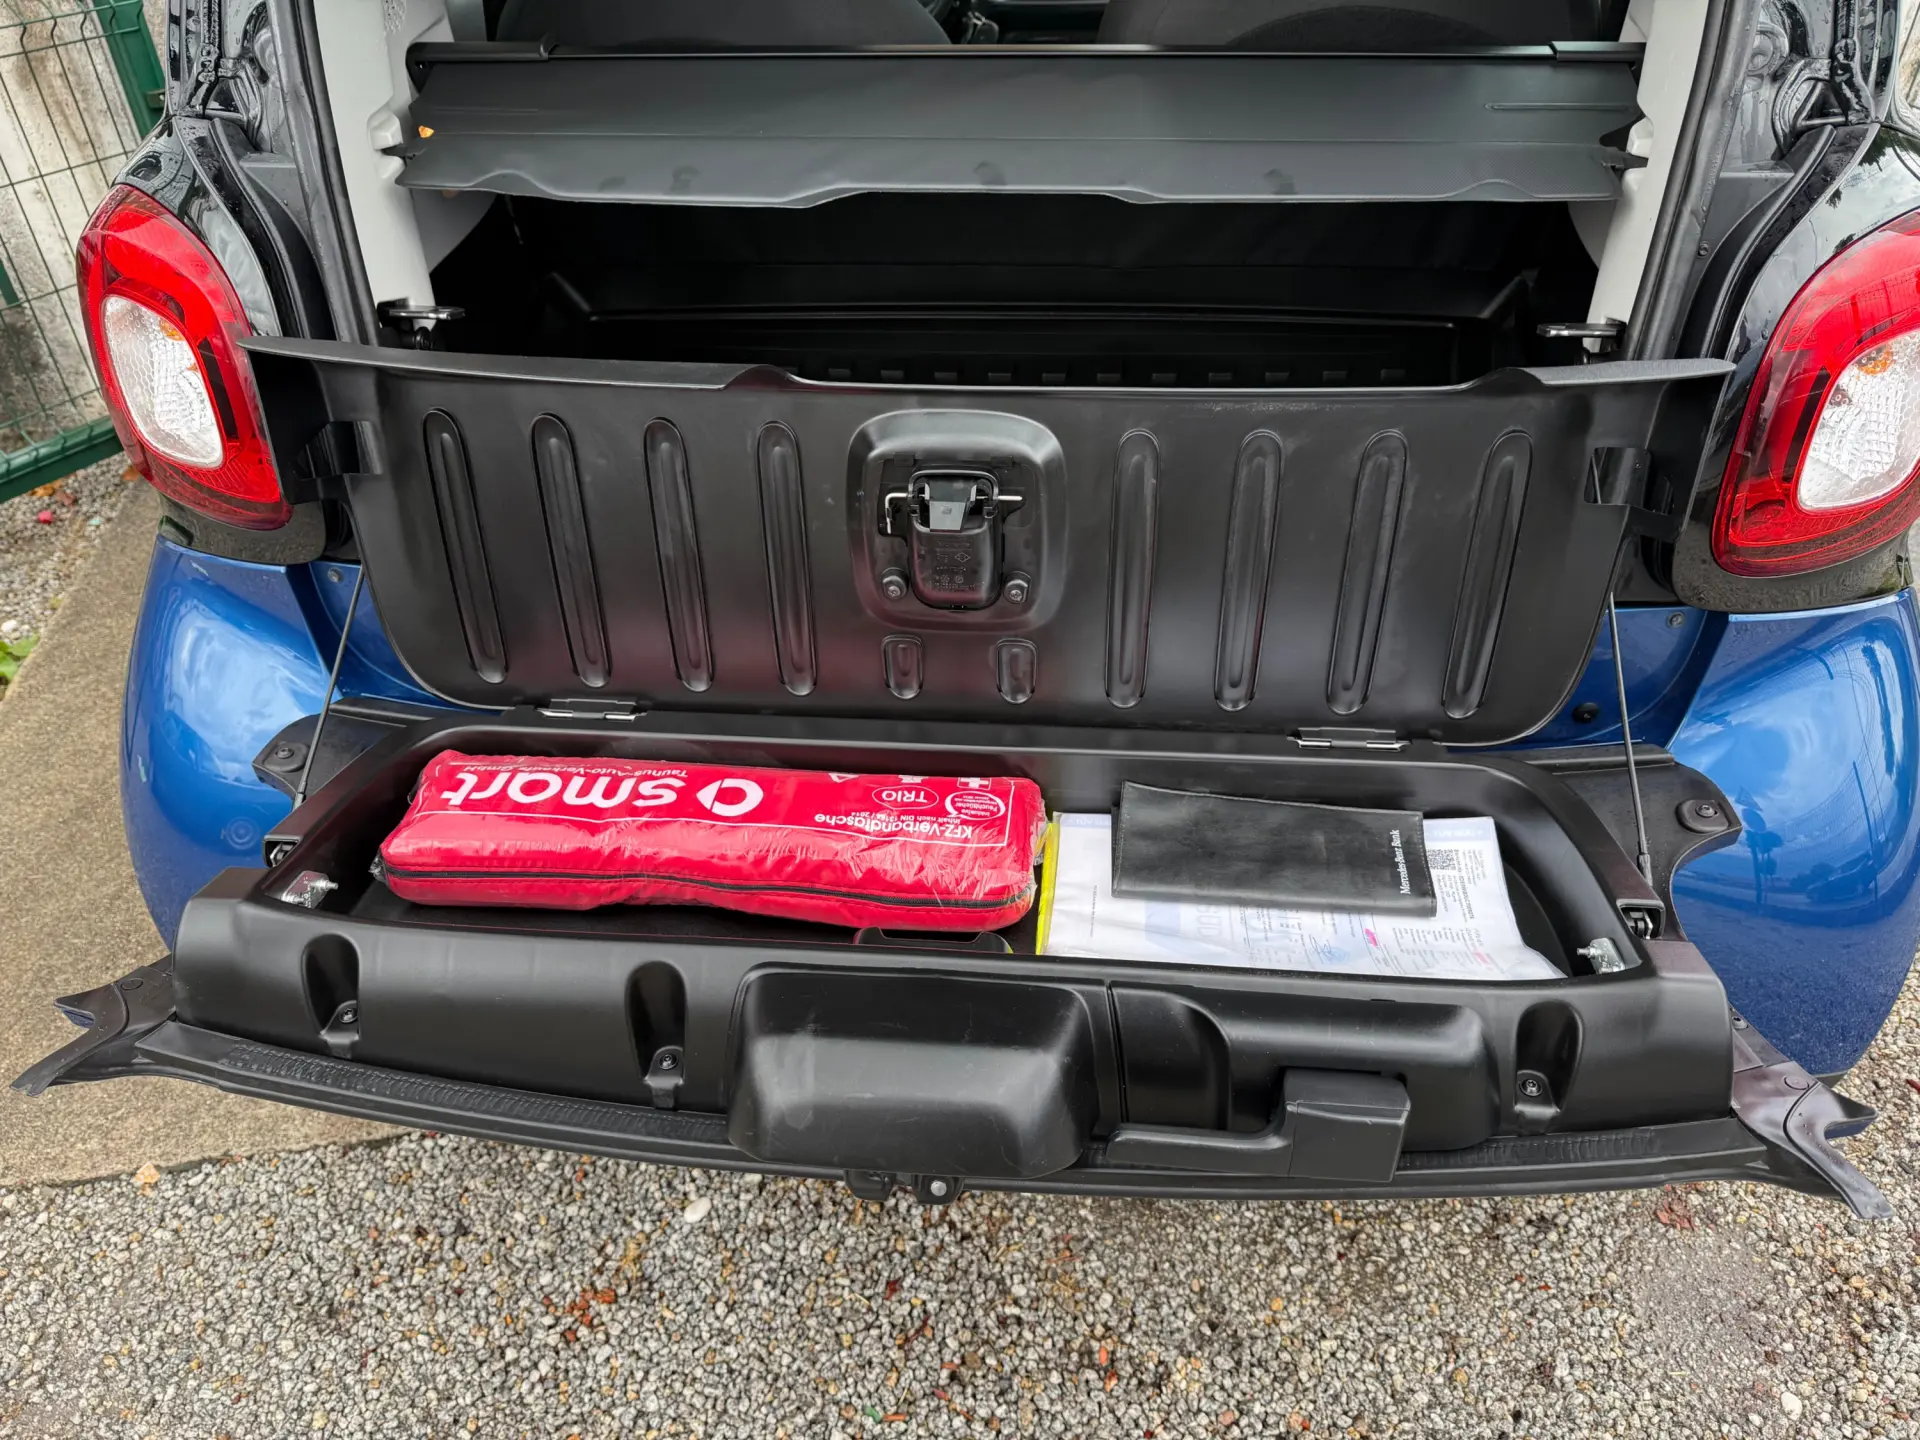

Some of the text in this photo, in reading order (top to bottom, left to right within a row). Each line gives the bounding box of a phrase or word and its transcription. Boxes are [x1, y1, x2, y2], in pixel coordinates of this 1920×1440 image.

[440, 772, 686, 808] smart
[881, 790, 928, 803] TRIO
[815, 814, 973, 839] KFZ-Verbandtasche
[1390, 829, 1411, 895] Mercedes-Benz Bank
